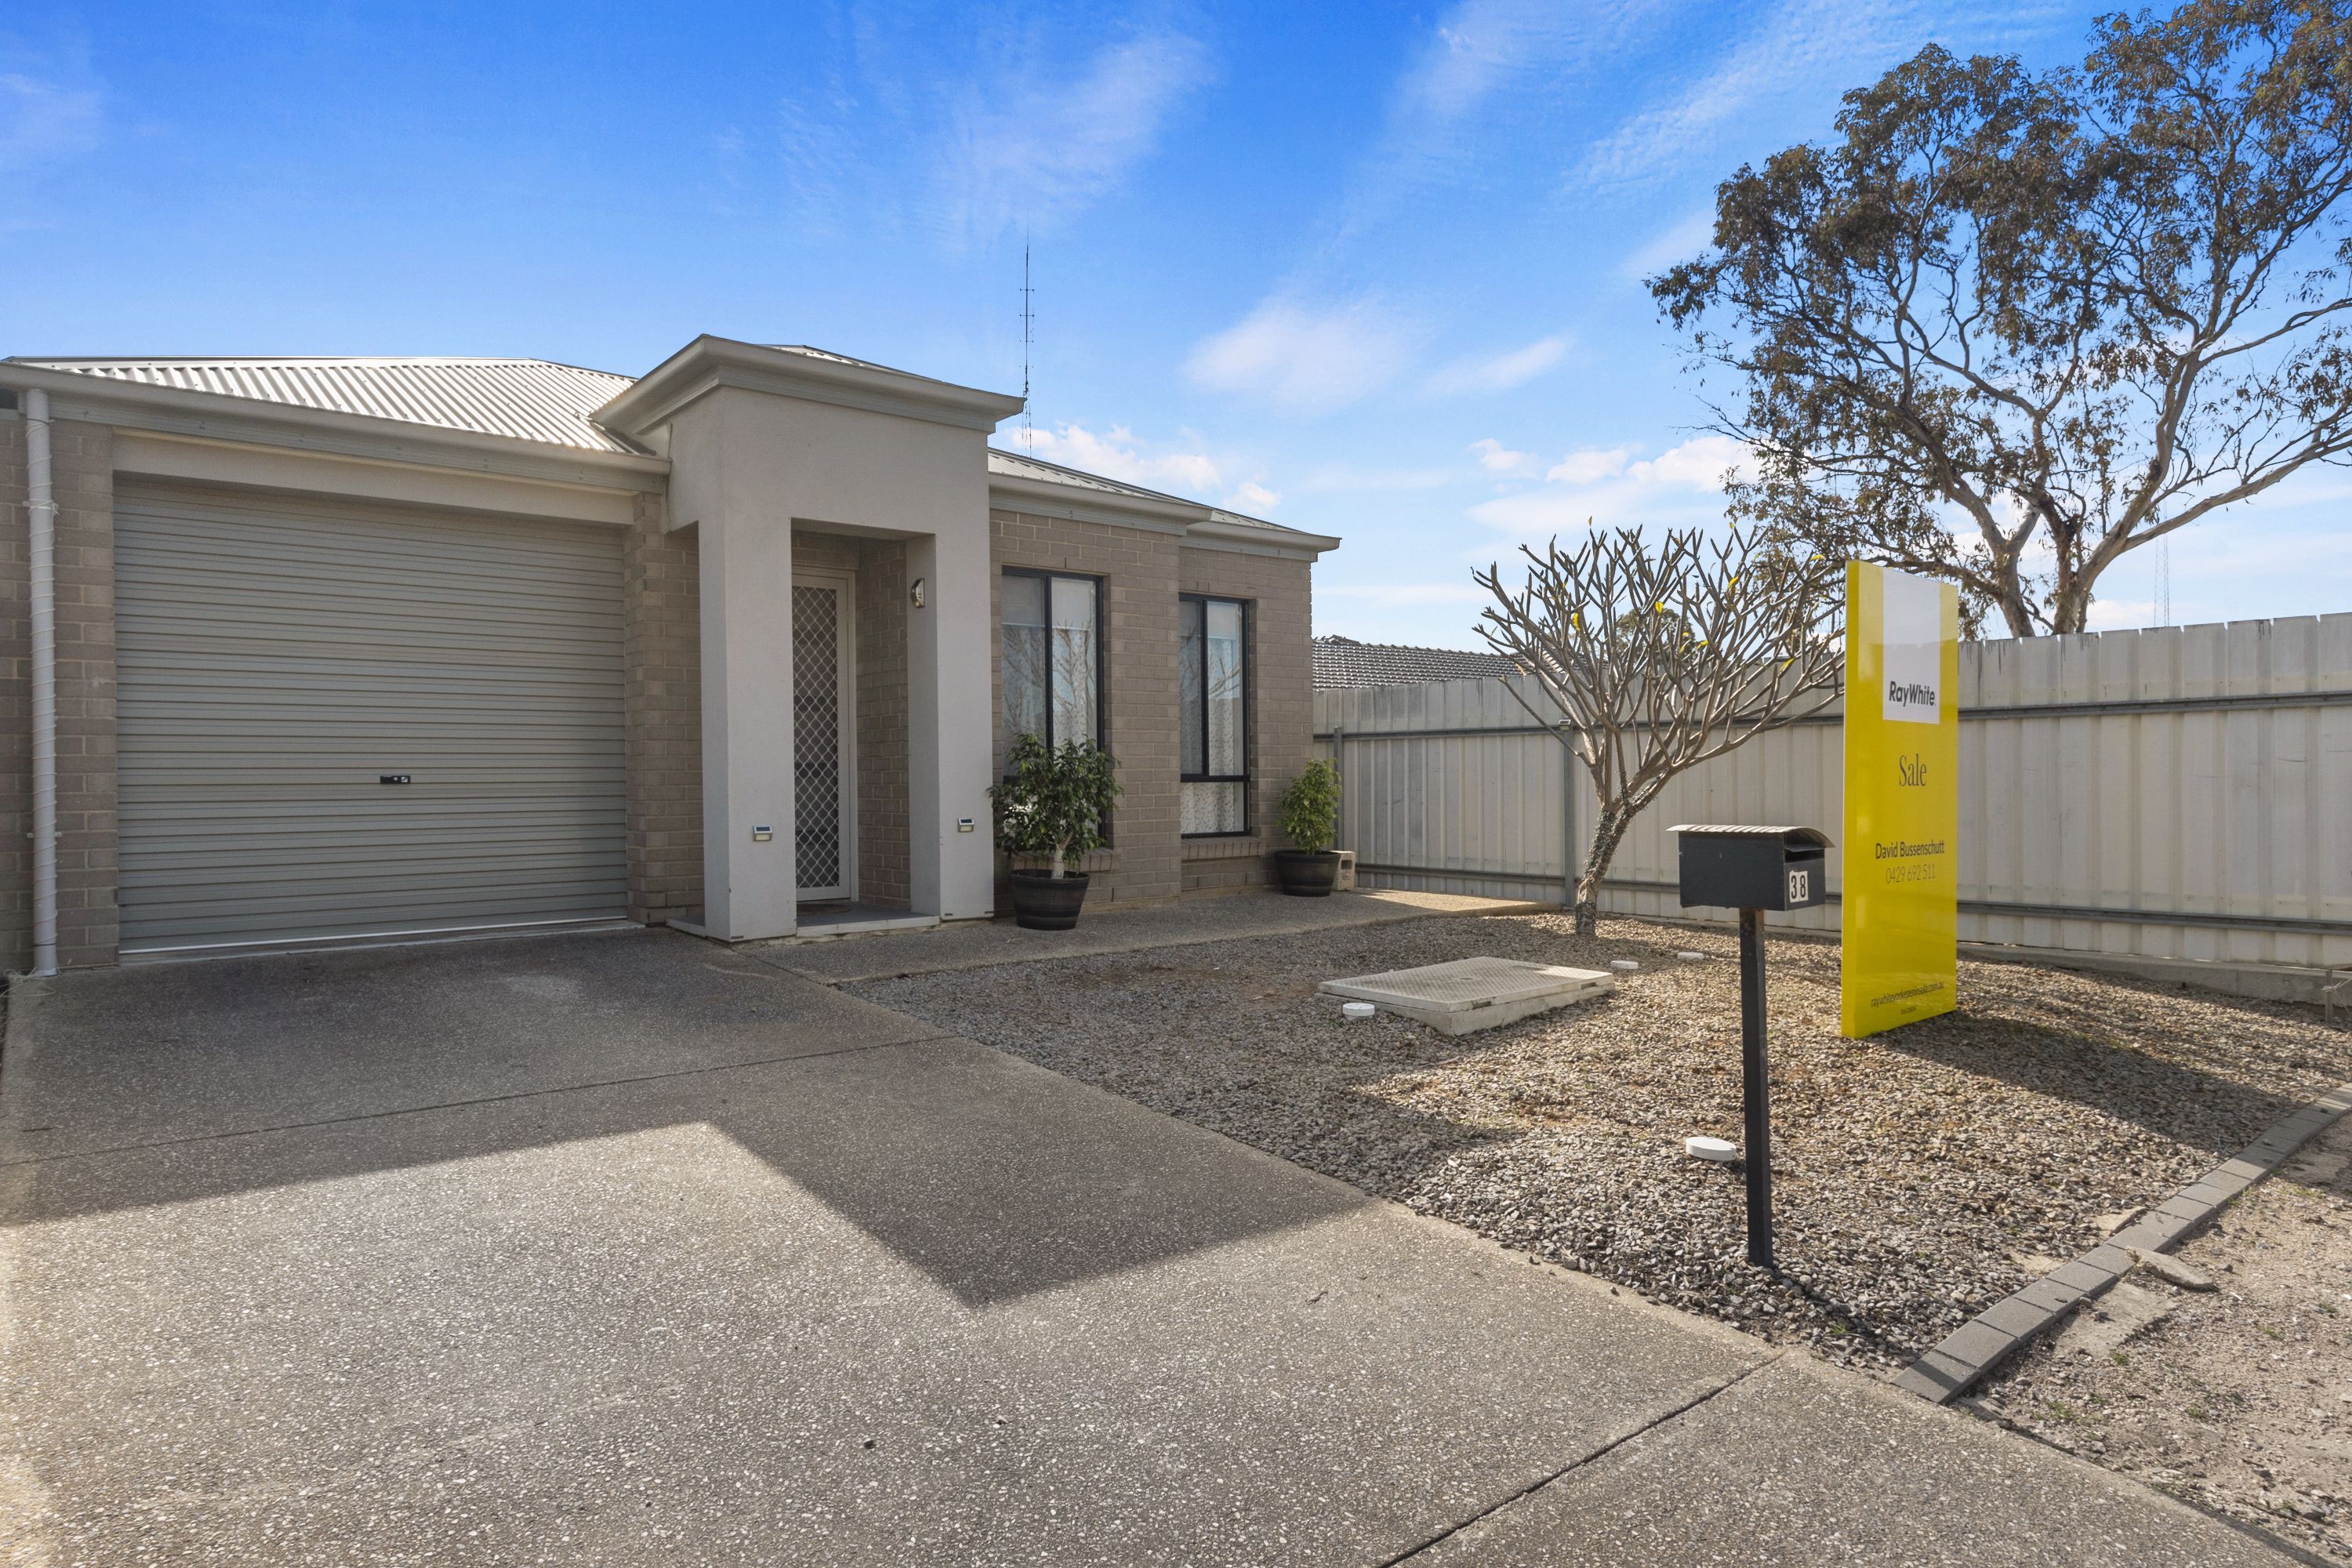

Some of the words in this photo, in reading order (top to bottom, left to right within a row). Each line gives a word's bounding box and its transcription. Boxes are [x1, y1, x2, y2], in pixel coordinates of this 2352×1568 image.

[1889, 681, 1935, 707] RayWhite
[1899, 753, 1927, 786] Sale
[1875, 841, 1898, 859] David
[1900, 839, 1945, 857] Bussenschutt
[1886, 866, 1905, 884] 0429
[1907, 864, 1922, 881] 692
[1923, 863, 1936, 880] 511
[1791, 874, 1806, 899] 38
